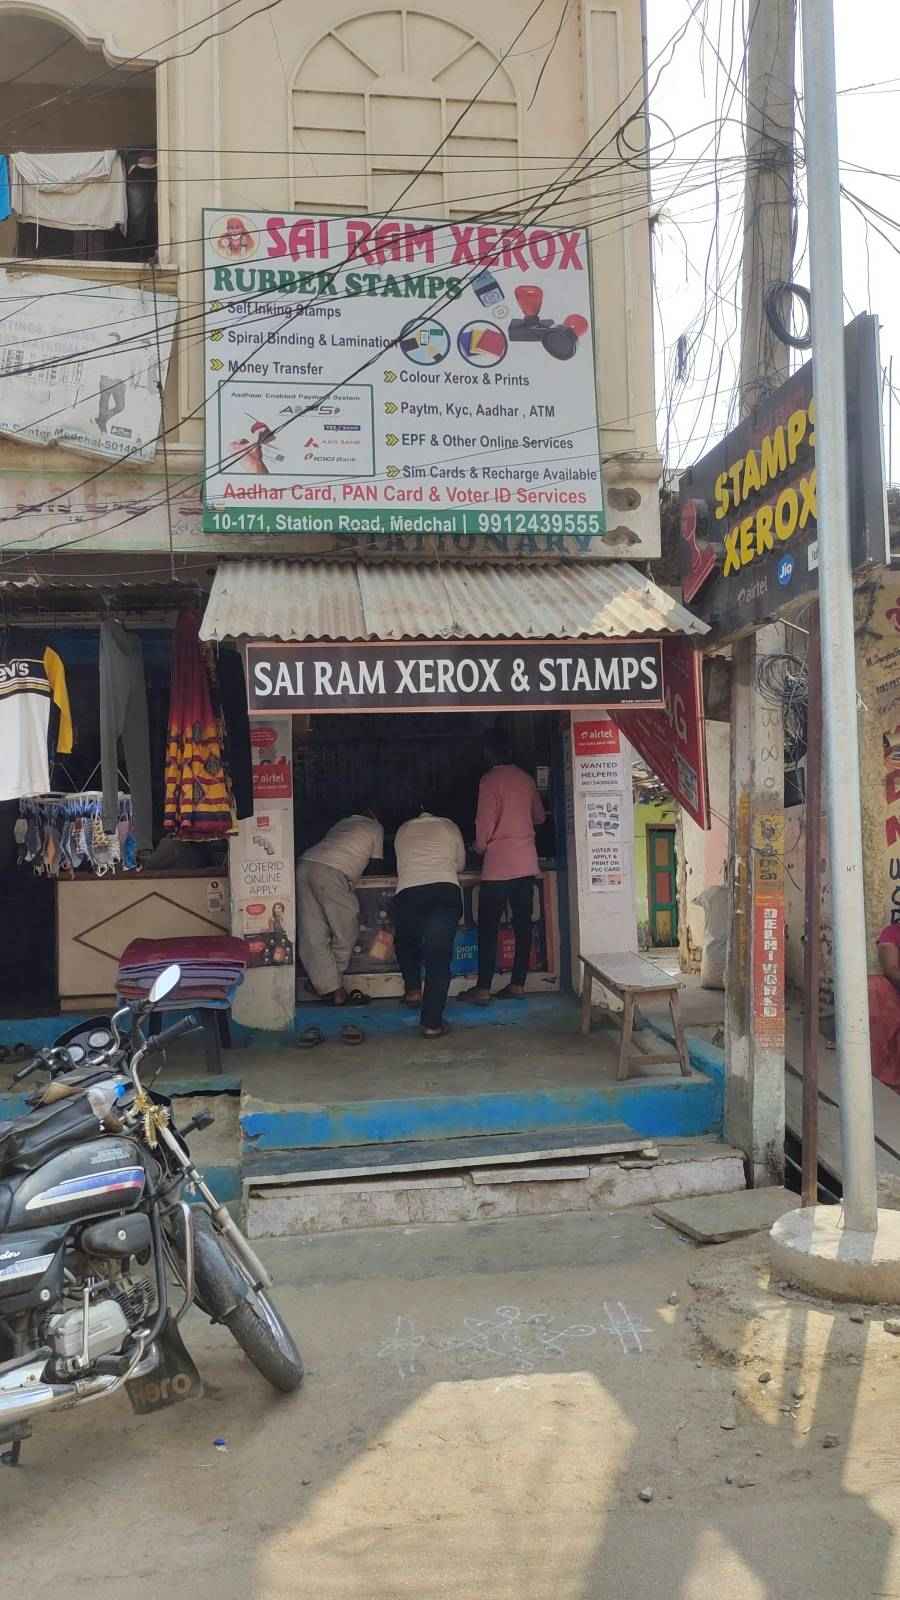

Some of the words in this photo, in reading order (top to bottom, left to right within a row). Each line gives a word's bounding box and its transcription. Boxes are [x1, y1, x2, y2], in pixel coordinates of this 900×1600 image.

[266, 217, 328, 261] SAI
[346, 220, 434, 265] RAM
[451, 225, 583, 272] XEROX
[213, 267, 337, 296] RUBBER
[345, 273, 463, 300] STAMPS
[296, 304, 341, 318] Stamps
[228, 330, 264, 345] Spiral
[268, 331, 315, 348] Binding
[318, 333, 327, 346] &
[331, 334, 399, 349] Lamination
[228, 360, 269, 376] Money
[273, 361, 324, 375] Transfer
[399, 370, 440, 384] Colour
[444, 371, 479, 385] Xerox
[482, 372, 491, 385] &
[495, 373, 530, 386] Prints
[400, 402, 442, 417] Paytm,
[446, 403, 473, 418] Kyc,
[476, 404, 519, 417] Aadhar
[529, 405, 555, 417] ATM
[402, 433, 426, 446] EPF
[430, 434, 439, 446] &
[443, 434, 476, 447] Other
[480, 435, 519, 448] Online
[522, 436, 573, 449] Services
[402, 465, 427, 478] Sim
[430, 465, 466, 479] Cards
[469, 467, 478, 479] &
[482, 467, 539, 482] Recharge
[543, 467, 597, 480] Available
[223, 483, 285, 501] Aadhar
[291, 484, 337, 502] Card,
[343, 485, 377, 501] PAN
[384, 486, 423, 502] Card
[429, 486, 440, 502] &
[446, 487, 489, 503] Voter
[495, 487, 511, 503] ID
[517, 488, 587, 504] Services
[212, 513, 270, 533] 10-171,
[275, 514, 333, 531] Station
[338, 515, 385, 533] Road,
[390, 515, 456, 532] Medchal
[478, 513, 600, 534] 9912439555
[723, 465, 819, 577] XEROX
[254, 661, 305, 697] SAI
[314, 660, 384, 696] RAM
[394, 658, 502, 695] XEROX
[510, 657, 530, 693] &
[539, 656, 658, 692] STAMPS
